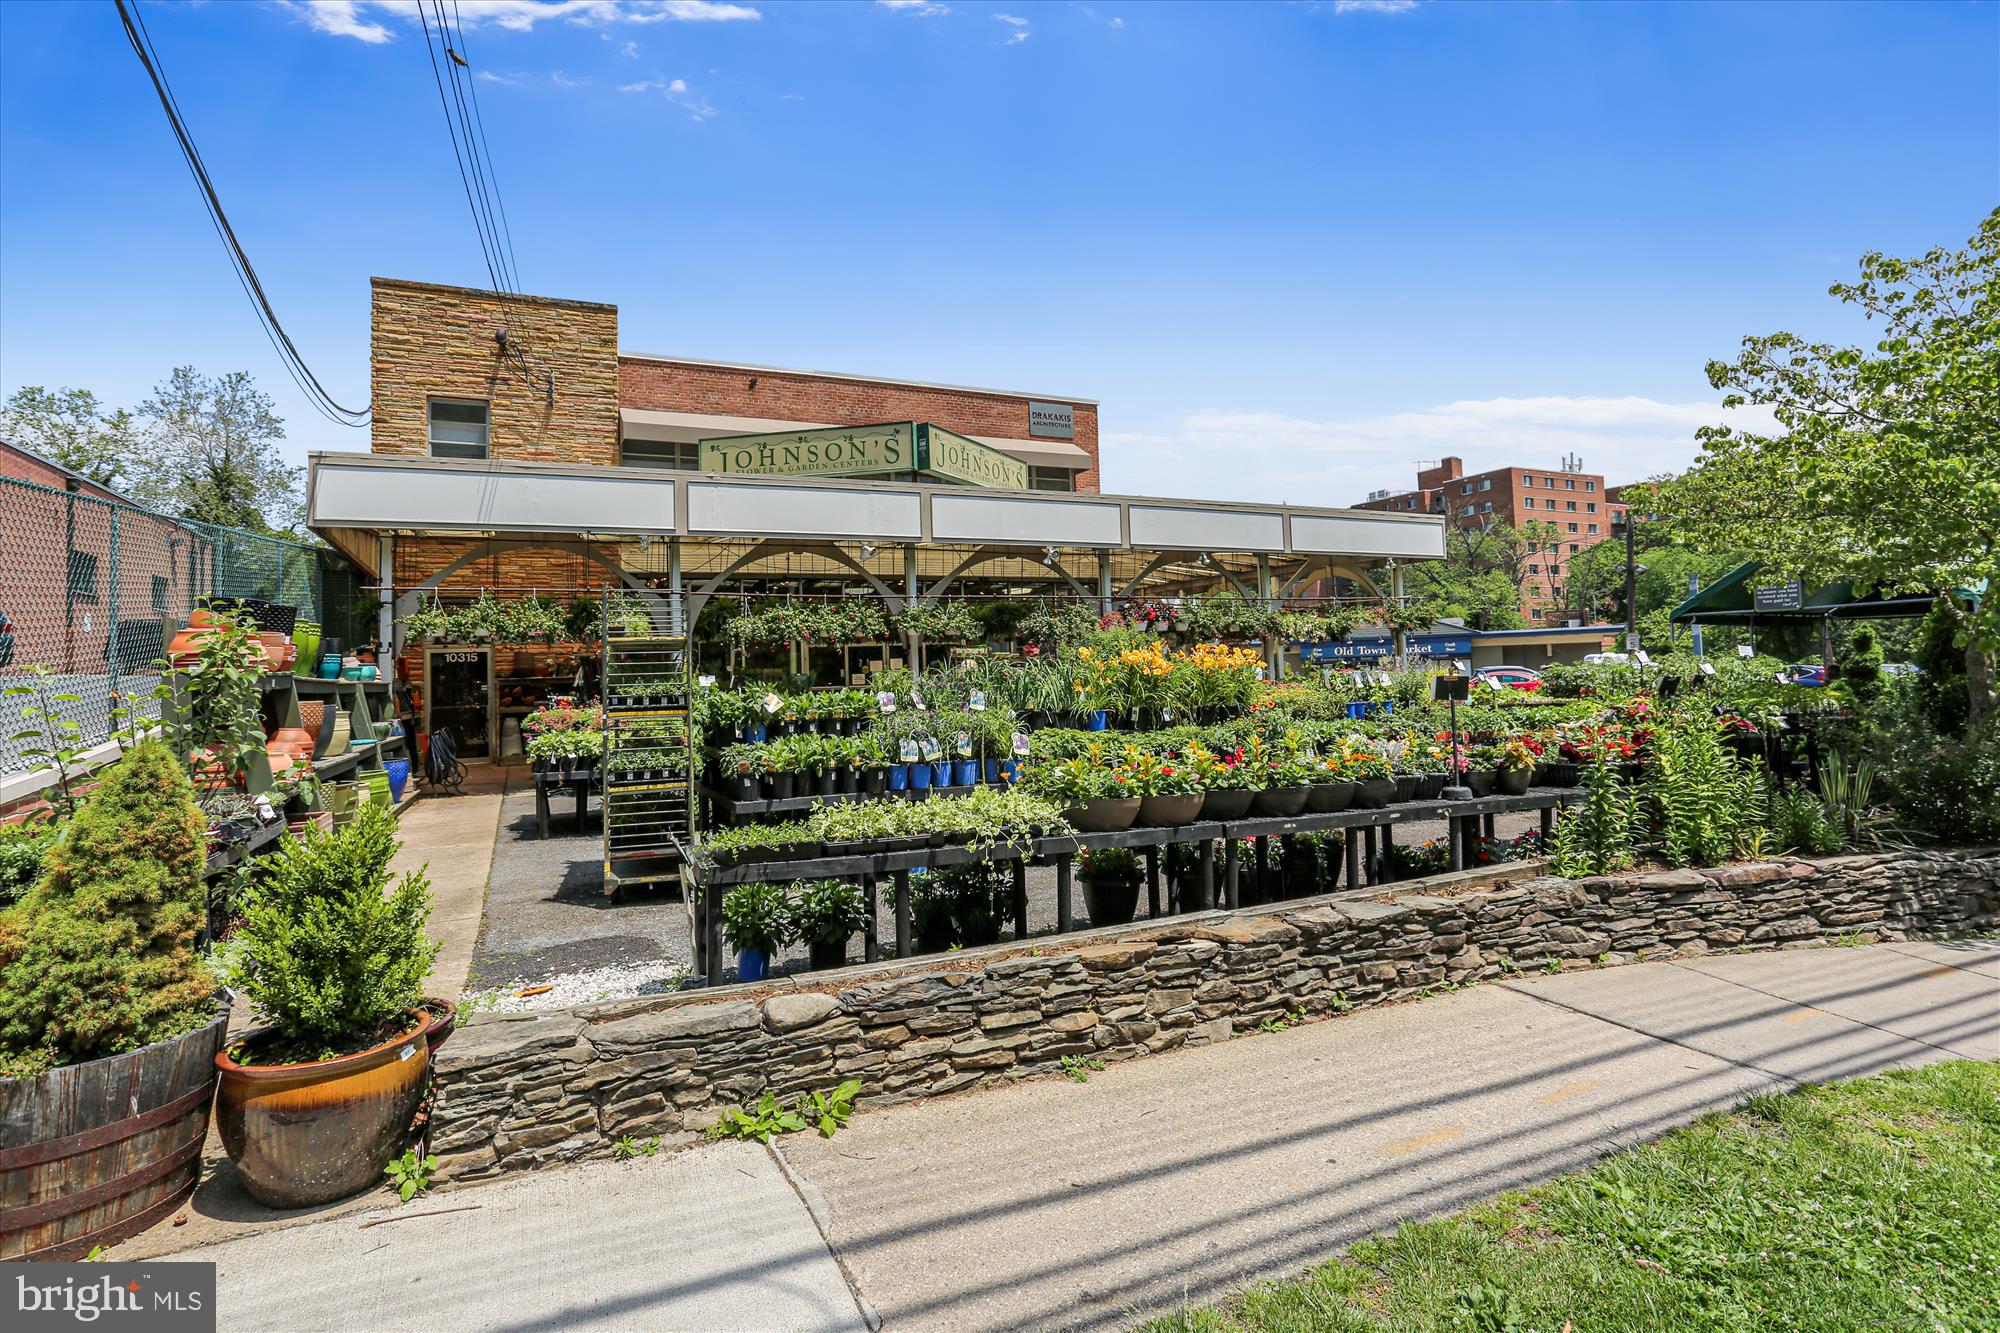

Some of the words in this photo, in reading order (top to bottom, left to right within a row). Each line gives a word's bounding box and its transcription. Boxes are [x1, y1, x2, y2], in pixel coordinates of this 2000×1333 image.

[1032, 411, 1071, 422] DRAKAKIS
[1032, 420, 1071, 429] ARCHITECTURE
[712, 438, 900, 473] JOHNSON'S
[788, 463, 828, 472] GARDEN
[833, 459, 879, 469] CENTERS
[936, 443, 1023, 488] JOHNSON'S
[1334, 646, 1354, 656] Old
[1357, 646, 1387, 655] Town
[444, 652, 479, 663] 10315
